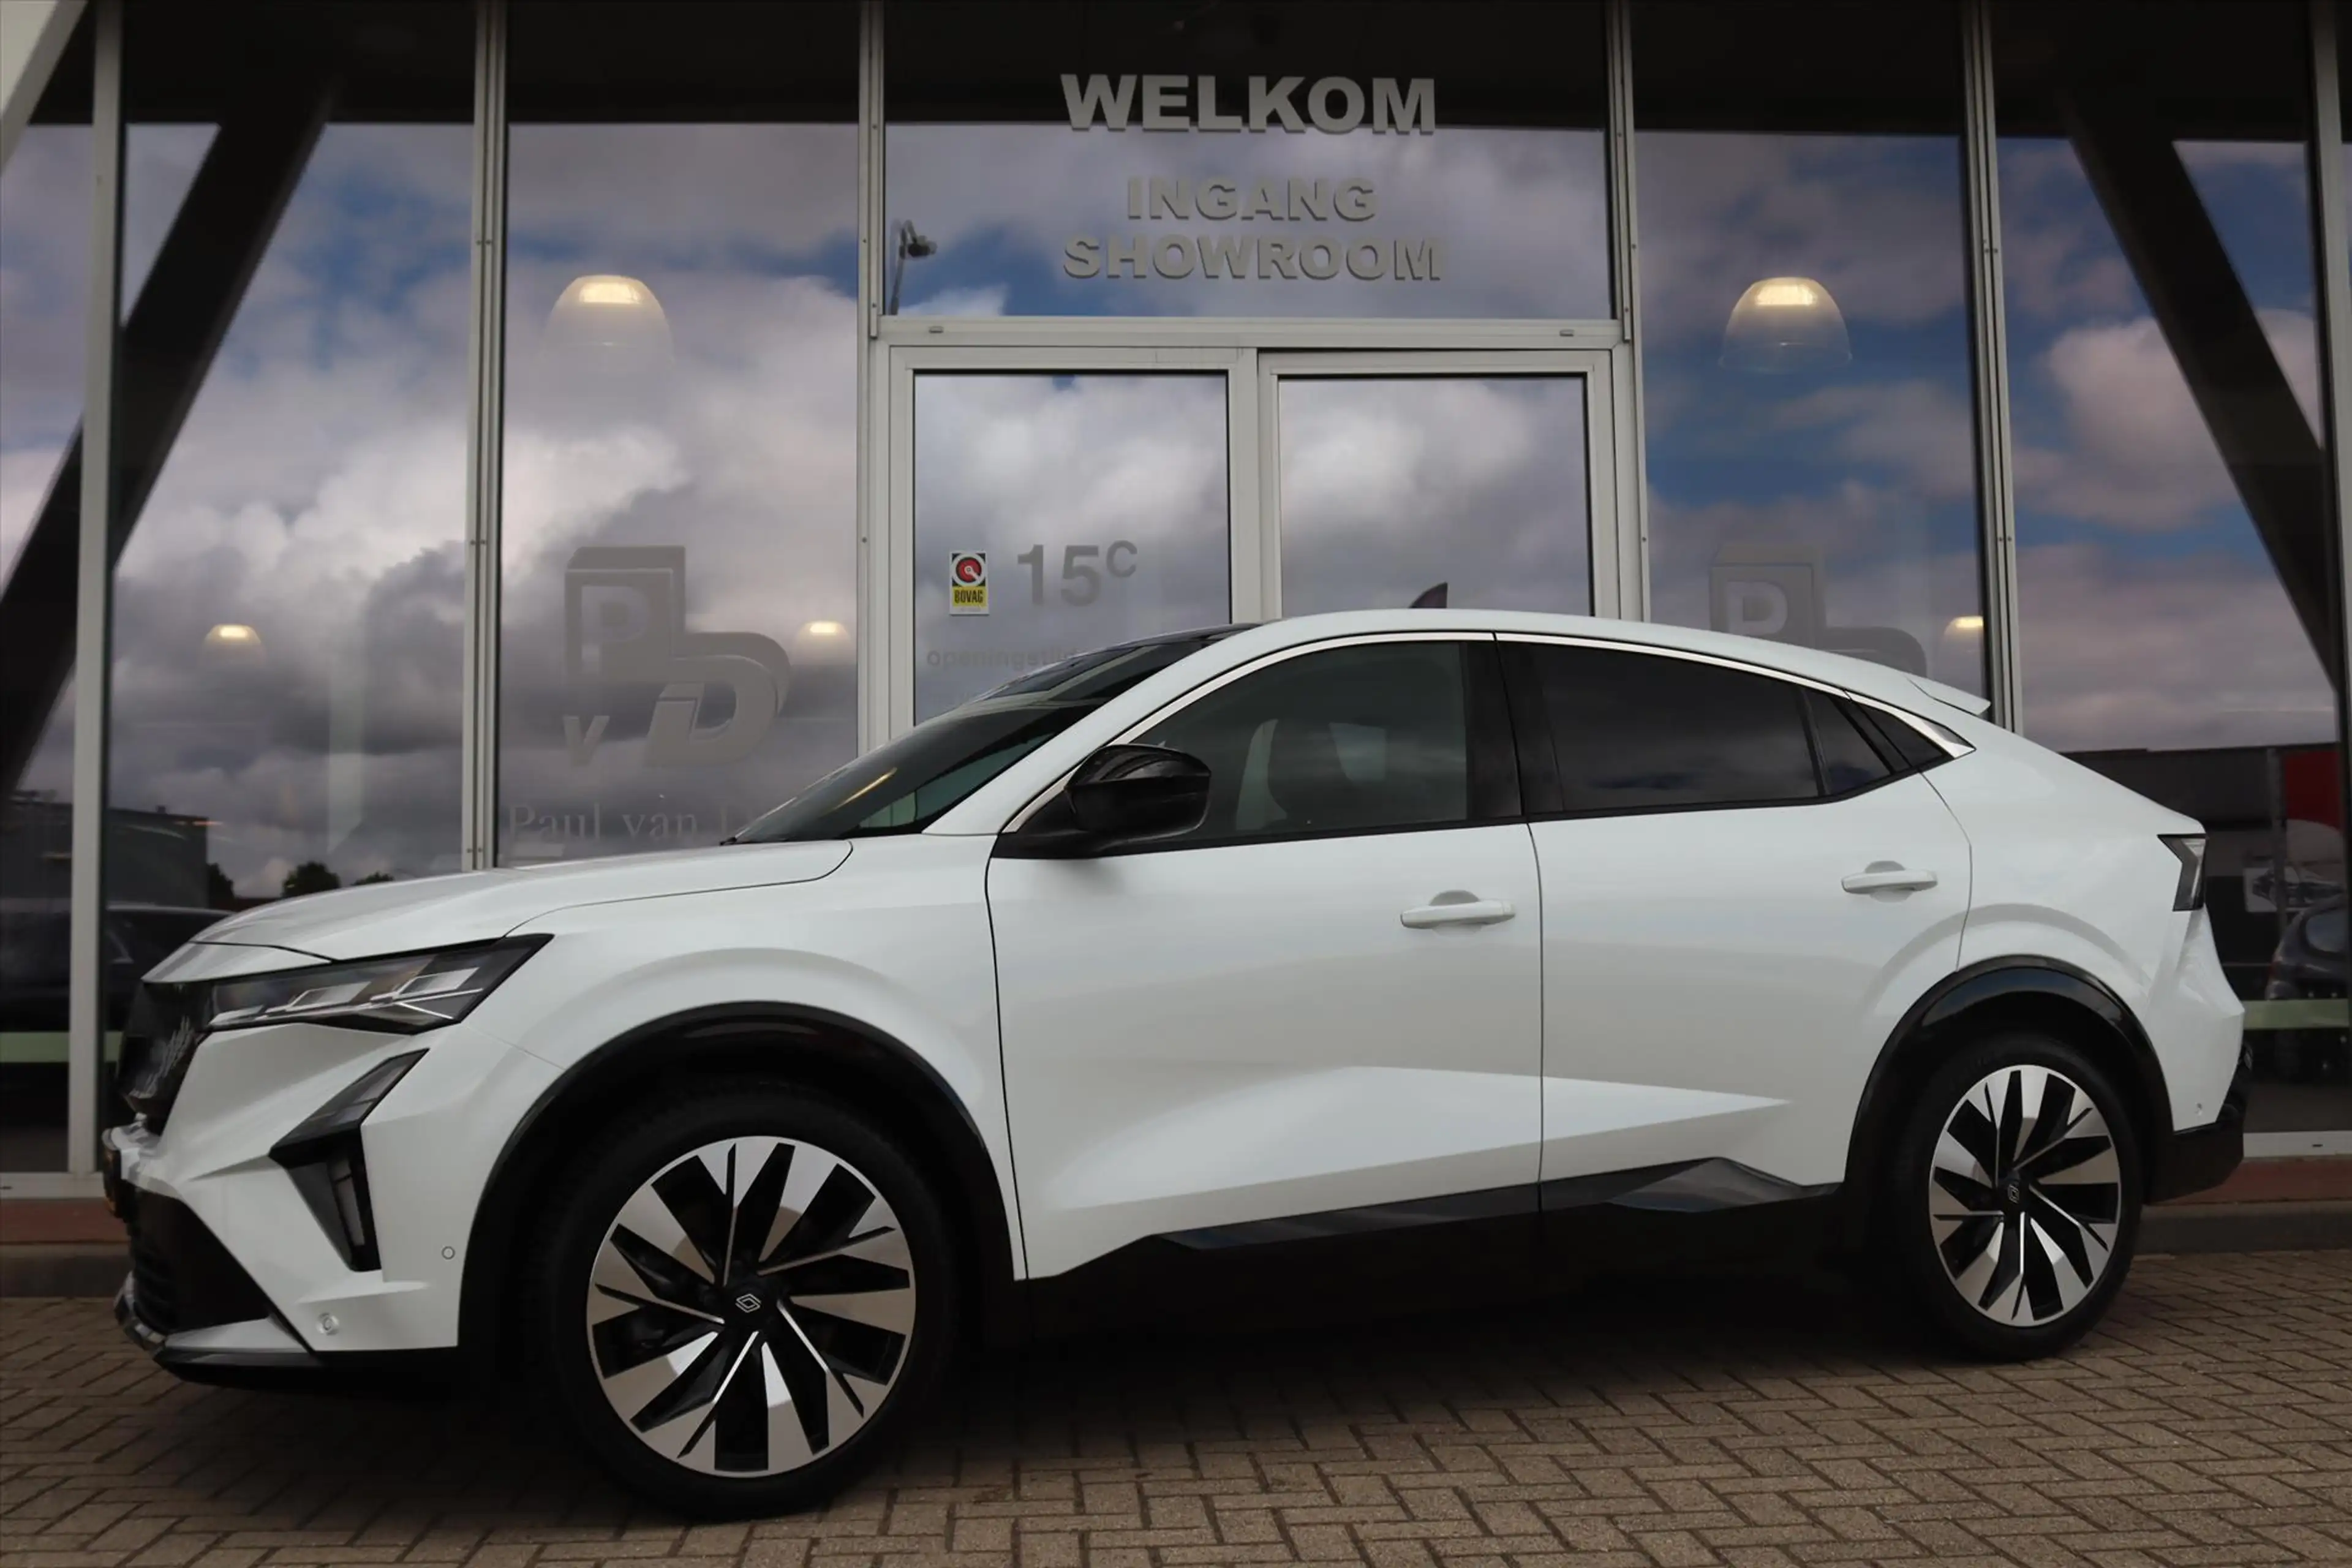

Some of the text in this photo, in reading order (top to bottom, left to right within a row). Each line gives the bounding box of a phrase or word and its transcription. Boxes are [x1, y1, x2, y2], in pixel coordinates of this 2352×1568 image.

[1060, 73, 1435, 135] WELKOM
[1127, 178, 1378, 221] INGANG
[1063, 235, 1443, 281] SHOWROOM
[954, 590, 984, 603] BOVAG
[508, 802, 601, 841] Paul
[622, 812, 698, 843] van
